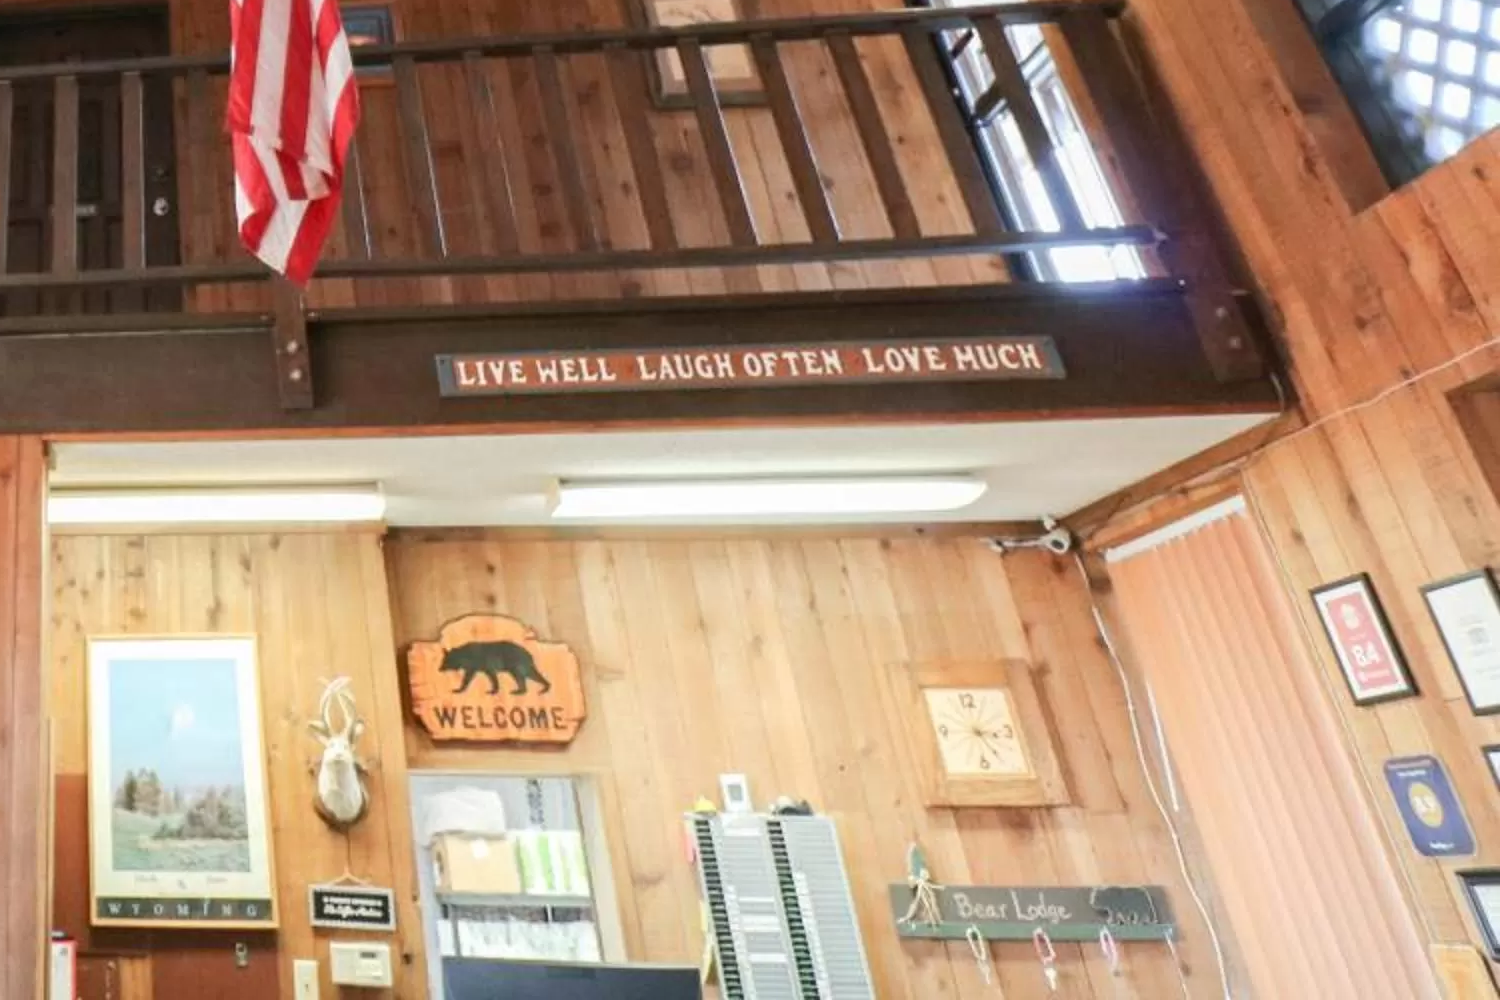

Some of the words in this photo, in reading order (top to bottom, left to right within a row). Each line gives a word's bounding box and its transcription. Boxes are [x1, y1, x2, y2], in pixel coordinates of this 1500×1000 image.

[456, 360, 528, 386] LIVE
[536, 356, 617, 384] WELL
[636, 352, 736, 381] LAUGH
[742, 349, 844, 377] OFTEN
[861, 345, 947, 373] LOVE
[952, 343, 1043, 372] MUCH
[958, 692, 977, 709] 12
[432, 705, 568, 729] WELCOME
[107, 903, 260, 917] WYOMING
[952, 891, 1008, 920] Bear
[1010, 888, 1073, 925] Lodge
